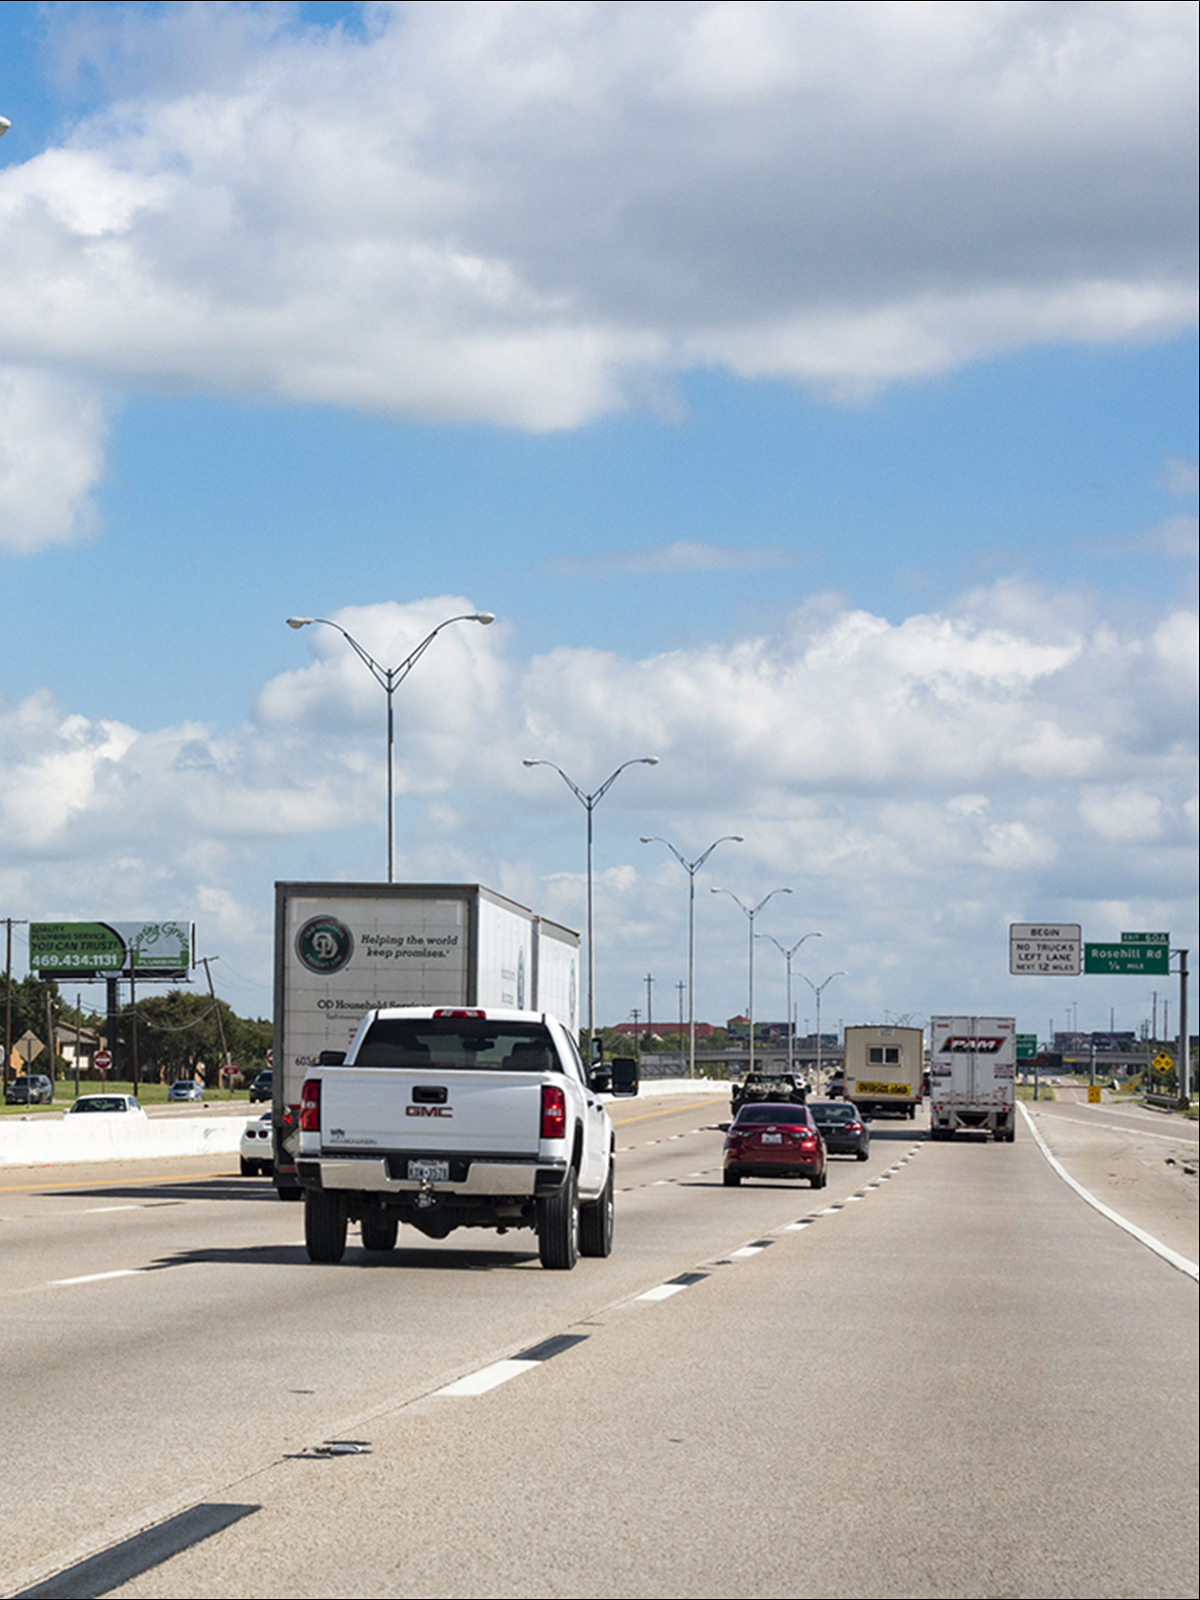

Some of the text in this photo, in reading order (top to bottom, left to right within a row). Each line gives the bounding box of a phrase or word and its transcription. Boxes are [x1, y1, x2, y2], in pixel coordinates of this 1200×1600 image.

[31, 925, 65, 933] QUALITY
[1030, 928, 1060, 936] BEGIN
[360, 934, 459, 947] Helping the world
[1145, 933, 1167, 941] 60A
[31, 941, 118, 951] YOU CAN TRUST!
[1016, 943, 1074, 951] NO TRUCKS
[366, 947, 393, 959] keep
[1018, 953, 1072, 961] LEFT LANE
[1091, 948, 1162, 959] Rosehill Rd
[31, 954, 117, 967] 469.434.1131
[1038, 962, 1050, 971] 12
[317, 999, 335, 1009] OD
[336, 999, 387, 1009] Household
[952, 1040, 997, 1049] PAM
[405, 1106, 454, 1118] GMC
